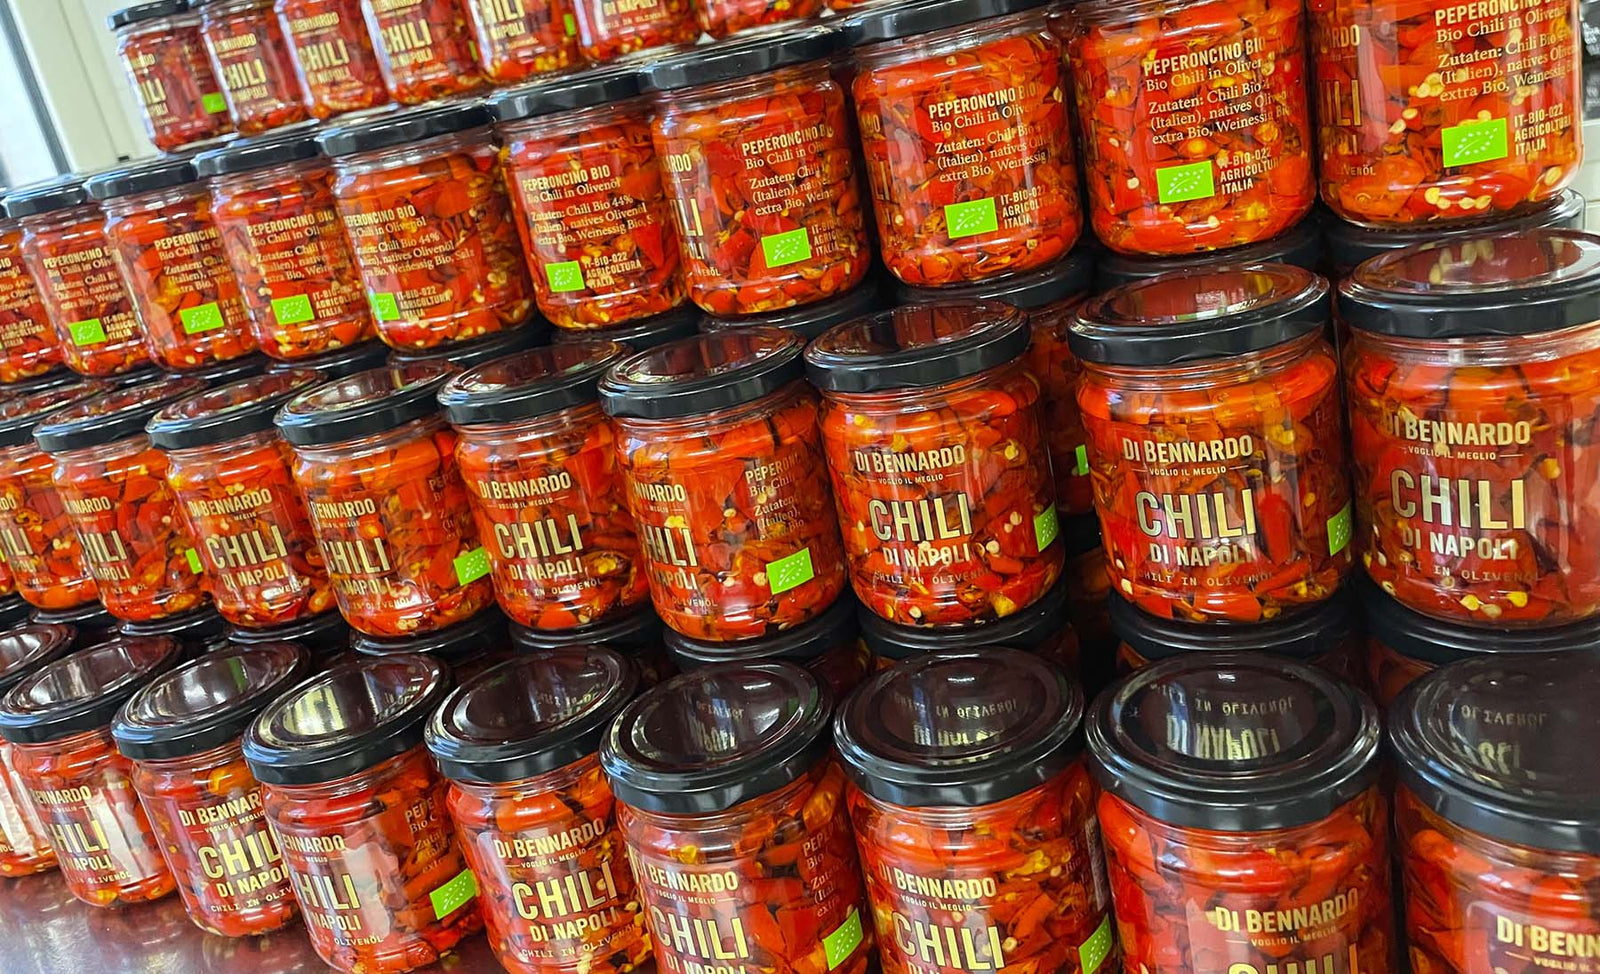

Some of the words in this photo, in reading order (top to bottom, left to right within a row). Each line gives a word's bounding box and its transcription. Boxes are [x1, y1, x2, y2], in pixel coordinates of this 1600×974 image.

[1436, 28, 1462, 43] Bio
[1467, 17, 1505, 37] Chili
[1509, 16, 1522, 29] in
[1143, 42, 1242, 77] PEPERONCINO
[1439, 48, 1502, 68] Zutaten:
[1505, 36, 1537, 54] Chili
[1507, 53, 1548, 72] natives
[1146, 79, 1168, 92] Bio
[1171, 71, 1205, 88] Chili
[1208, 68, 1222, 80] in
[1441, 88, 1478, 102] extra
[1482, 81, 1509, 95] Bio,
[929, 87, 1016, 119] PEPERONCINO
[1148, 95, 1204, 115] Zutaten:
[1207, 88, 1238, 104] Chili
[1242, 80, 1262, 96] Bio
[932, 121, 952, 133] Bio
[954, 113, 985, 129] Chili
[987, 110, 1000, 122] in
[1150, 112, 1206, 132] (Italien),
[1209, 100, 1252, 120] natives
[742, 126, 818, 157] PEPERONCINO
[935, 137, 985, 155] Zutaten:
[1152, 133, 1184, 145] extra
[1188, 126, 1213, 140] Bio,
[1515, 137, 1547, 157] ITALIA
[745, 156, 765, 170] Bio
[767, 150, 794, 165] Chili
[795, 147, 806, 159] in
[937, 150, 988, 171] (Italien),
[990, 143, 1027, 159] natives
[939, 172, 969, 183] extra
[972, 165, 995, 178] Bio,
[996, 151, 1046, 172] Weinessig
[590, 165, 611, 180] BIO
[750, 172, 795, 190] Zutaten:
[540, 187, 563, 202] Chili
[565, 186, 575, 197] in
[576, 177, 621, 196] Olivenöl
[752, 183, 798, 205] (Italien),
[1221, 178, 1254, 195] ITALIA
[396, 204, 416, 220] BIO
[566, 202, 591, 217] Chili
[593, 199, 610, 211] Bio
[611, 194, 634, 207] 44%
[570, 212, 604, 230] natives
[605, 201, 647, 223] Olivenöl
[755, 203, 783, 217] extra
[785, 197, 805, 210] Bio,
[247, 212, 315, 236] PEPERONCINO
[576, 222, 627, 241] Weinessig
[1004, 215, 1032, 229] ITALIA
[267, 231, 291, 245] Chili
[401, 237, 417, 249] Bio
[413, 241, 455, 258] Olivenöl
[586, 260, 642, 280] AGRICOLTURA
[1405, 415, 1531, 446] BENNARDO
[854, 450, 871, 473] DI
[872, 444, 966, 475] BENNARDO
[1122, 438, 1140, 462] DI
[1143, 434, 1253, 464] BENNARDO
[1457, 451, 1497, 460] MEGLIO
[915, 473, 944, 484] MEGLIO
[1149, 467, 1179, 476] VOGLIO
[1181, 468, 1190, 476] IL
[1192, 465, 1227, 476] MEGLIO
[478, 479, 492, 499] DI
[490, 471, 572, 500] BENNARDO
[199, 488, 272, 516] BENNARDO
[1390, 468, 1526, 530] CHILI
[868, 492, 973, 542] CHILI
[1135, 488, 1257, 540] CHILI
[205, 525, 288, 569] CHILI
[494, 513, 584, 559] CHILI
[1402, 527, 1422, 550] DI
[883, 546, 900, 566] DI
[905, 542, 971, 568] NAPOLI
[1150, 543, 1170, 565] DI
[236, 562, 289, 586] NAPOLI
[508, 564, 524, 580] DI
[178, 810, 197, 826] DI
[196, 790, 261, 825] BENNAR
[50, 820, 109, 853] HILI
[493, 838, 513, 859] DI
[513, 817, 605, 858] BENNARDO
[548, 856, 557, 865] IL
[558, 847, 586, 862] MEGLIO
[217, 882, 234, 898] DI
[296, 871, 361, 911] HILI
[511, 860, 618, 921] CHILI
[649, 866, 739, 893] BENNARDO
[893, 866, 997, 900] BENNARDO
[211, 903, 240, 912] CHILI
[246, 898, 259, 907] IN
[688, 895, 716, 905] MEGLIO
[929, 900, 938, 910] IL
[939, 902, 971, 912] MEGLIO
[1215, 906, 1240, 933] DI
[1245, 887, 1358, 933] BENNARDO
[530, 925, 549, 942] DI
[552, 906, 617, 941] NAPOLI
[650, 904, 750, 961] CHILI
[1497, 915, 1523, 947] DI
[1530, 924, 1600, 957] BENN
[891, 910, 1006, 970] CHILI
[1250, 937, 1287, 948] VOGLIO
[1290, 936, 1299, 944] IL
[1303, 926, 1337, 942] MEGLIO
[561, 947, 576, 957] IN
[664, 951, 681, 973] DI
